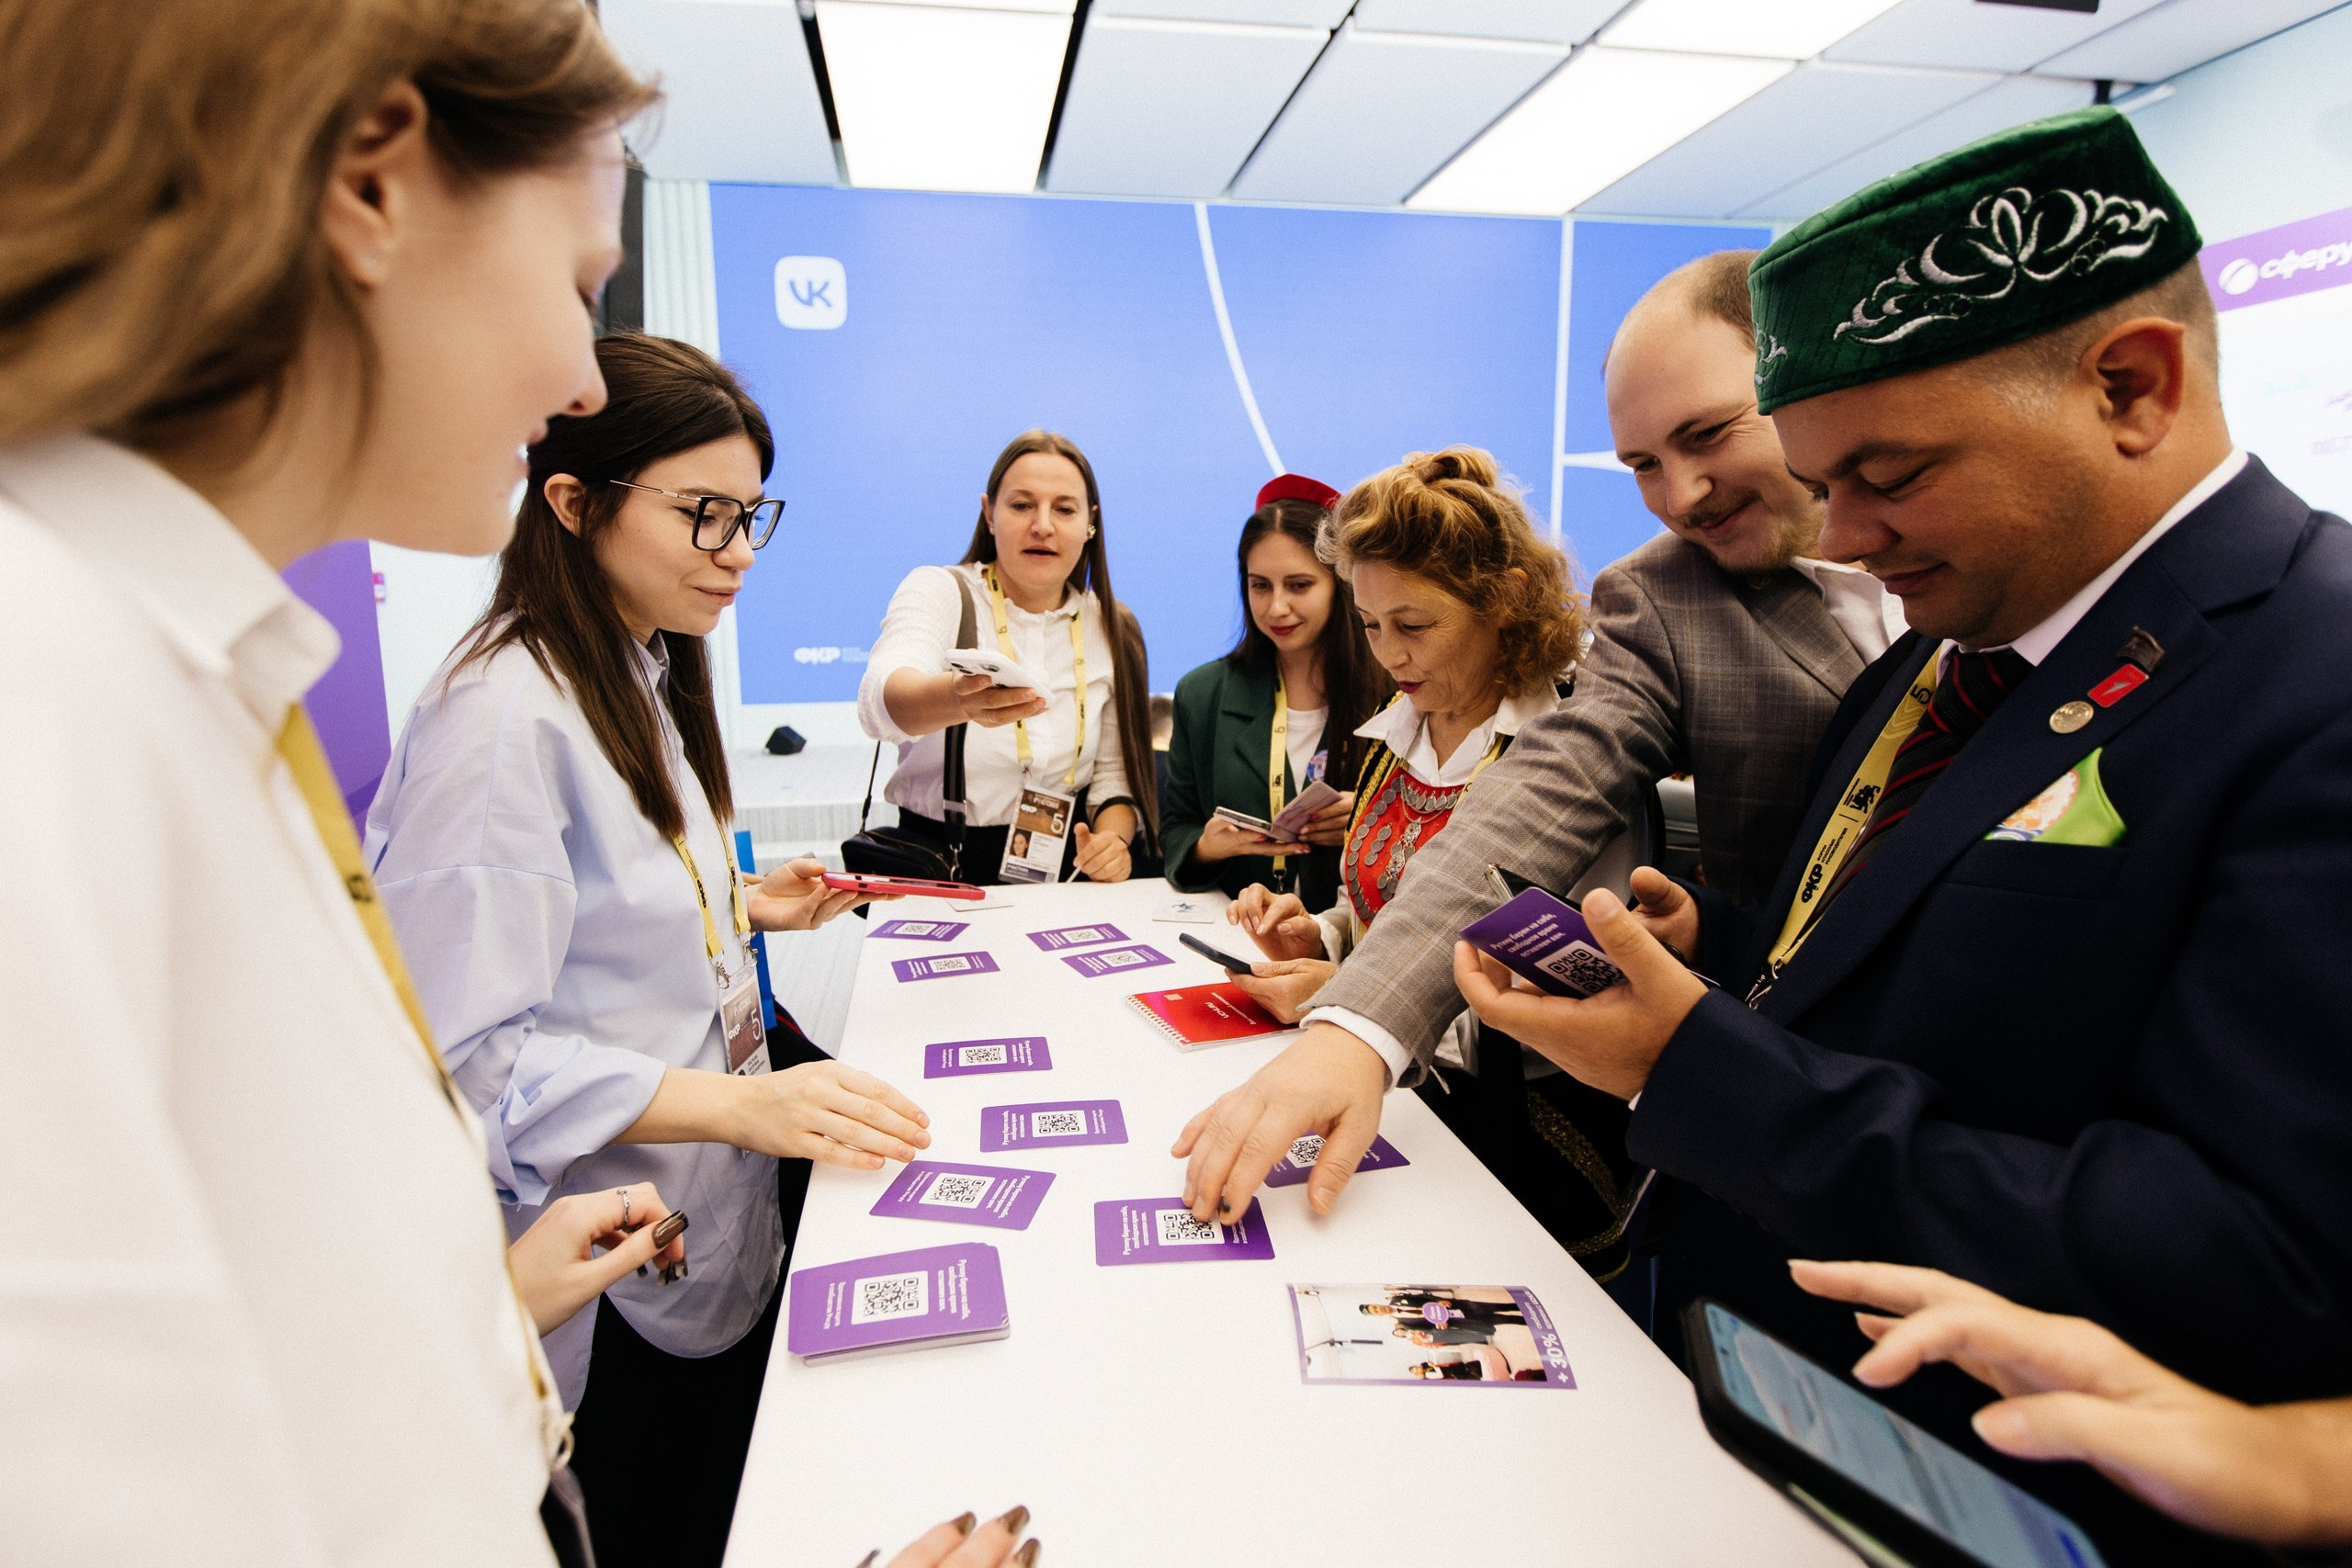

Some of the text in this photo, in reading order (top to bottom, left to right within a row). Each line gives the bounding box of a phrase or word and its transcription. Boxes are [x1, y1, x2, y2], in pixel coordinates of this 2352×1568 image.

[789, 280, 831, 308] VK
[1051, 813, 1064, 834] 5
[1801, 863, 1823, 904] ФКР
[1490, 937, 1513, 950] Рутину
[752, 1009, 762, 1040] 5
[1542, 1334, 1567, 1369] 30%
